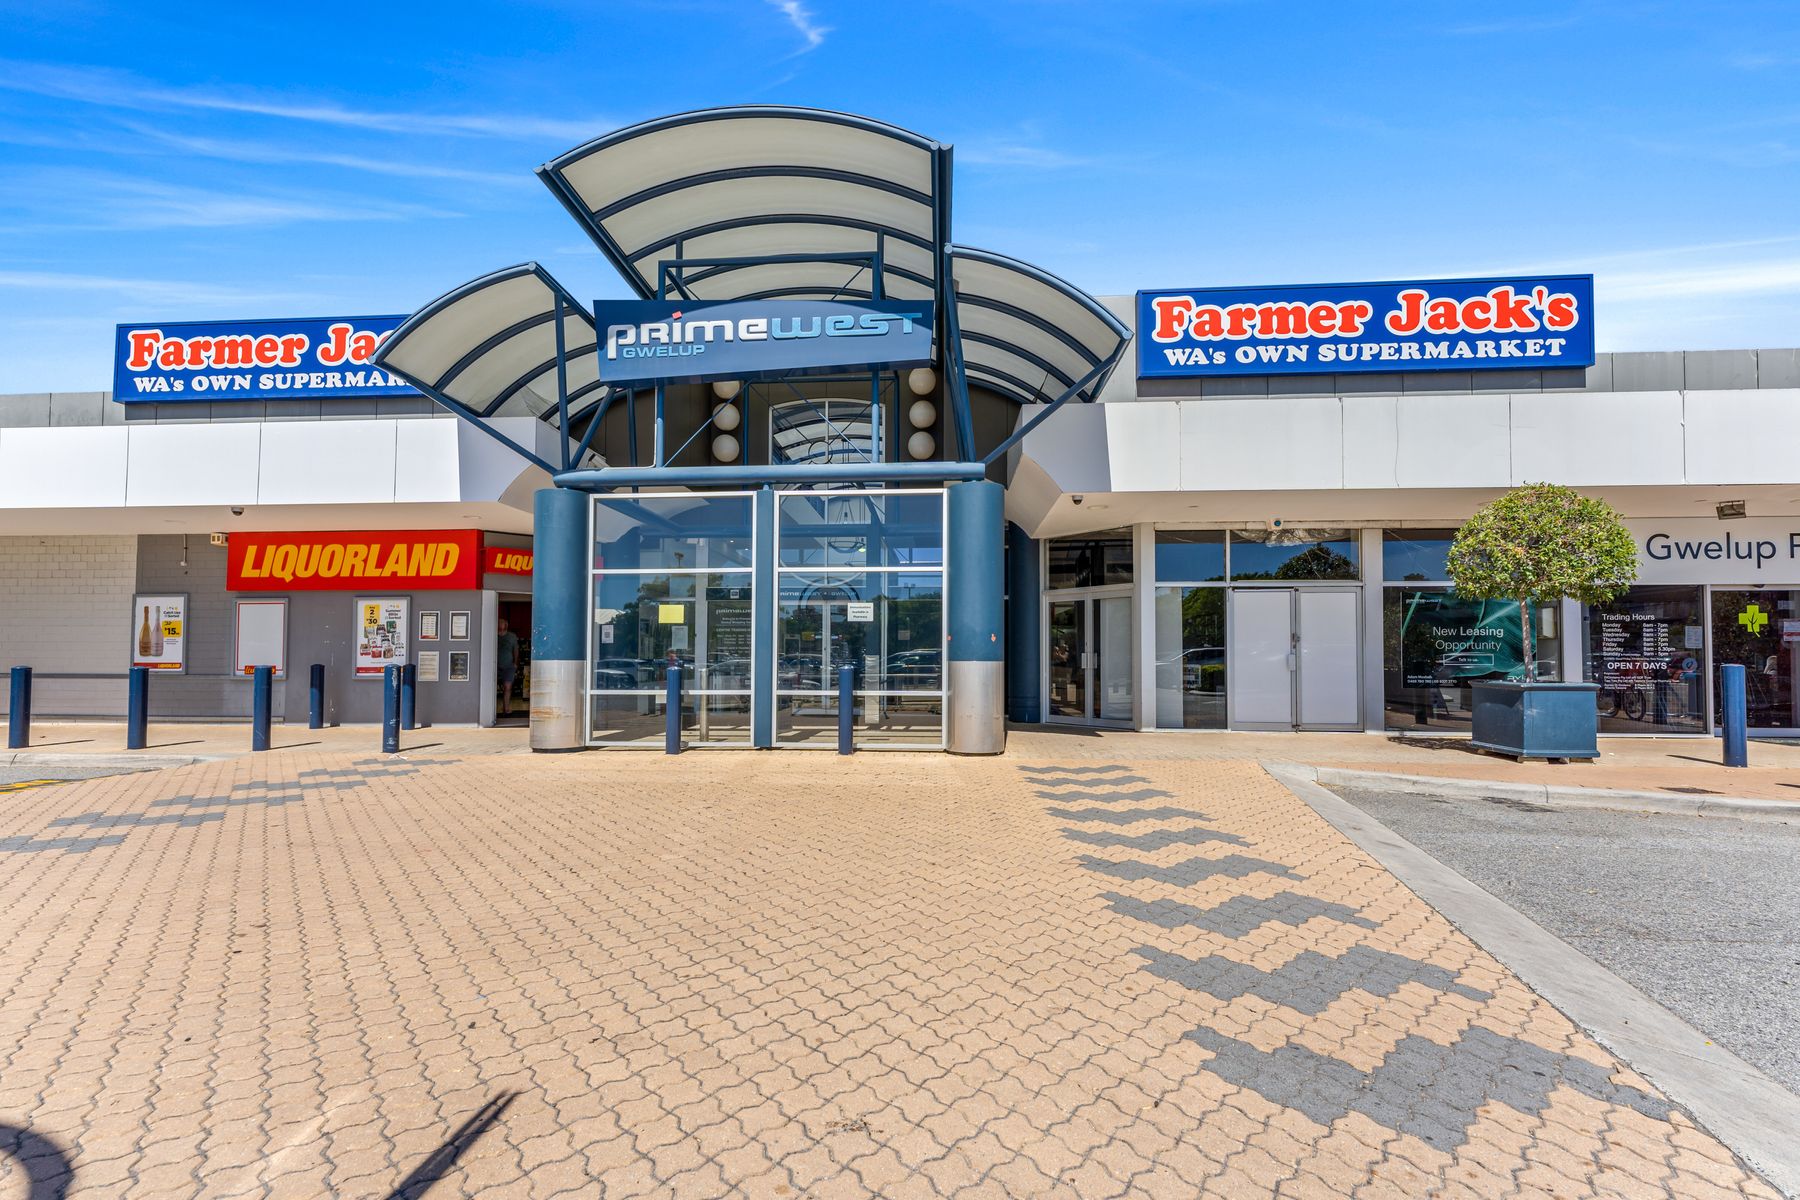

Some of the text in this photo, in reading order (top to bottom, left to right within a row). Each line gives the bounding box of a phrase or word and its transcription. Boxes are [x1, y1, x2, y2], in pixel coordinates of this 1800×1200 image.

[1152, 285, 1579, 342] Farmer Jack's
[126, 329, 310, 371] Farmer
[622, 344, 706, 359] GWELUP
[1163, 338, 1566, 367] WA's OWN SUPERMARKET
[133, 376, 185, 393] WA's
[191, 374, 253, 391] OWN
[240, 542, 460, 583] LIQUORLAND
[1646, 531, 1777, 569] Gwelup
[1433, 627, 1504, 637] New Leasing
[1436, 640, 1502, 651] Opportunity
